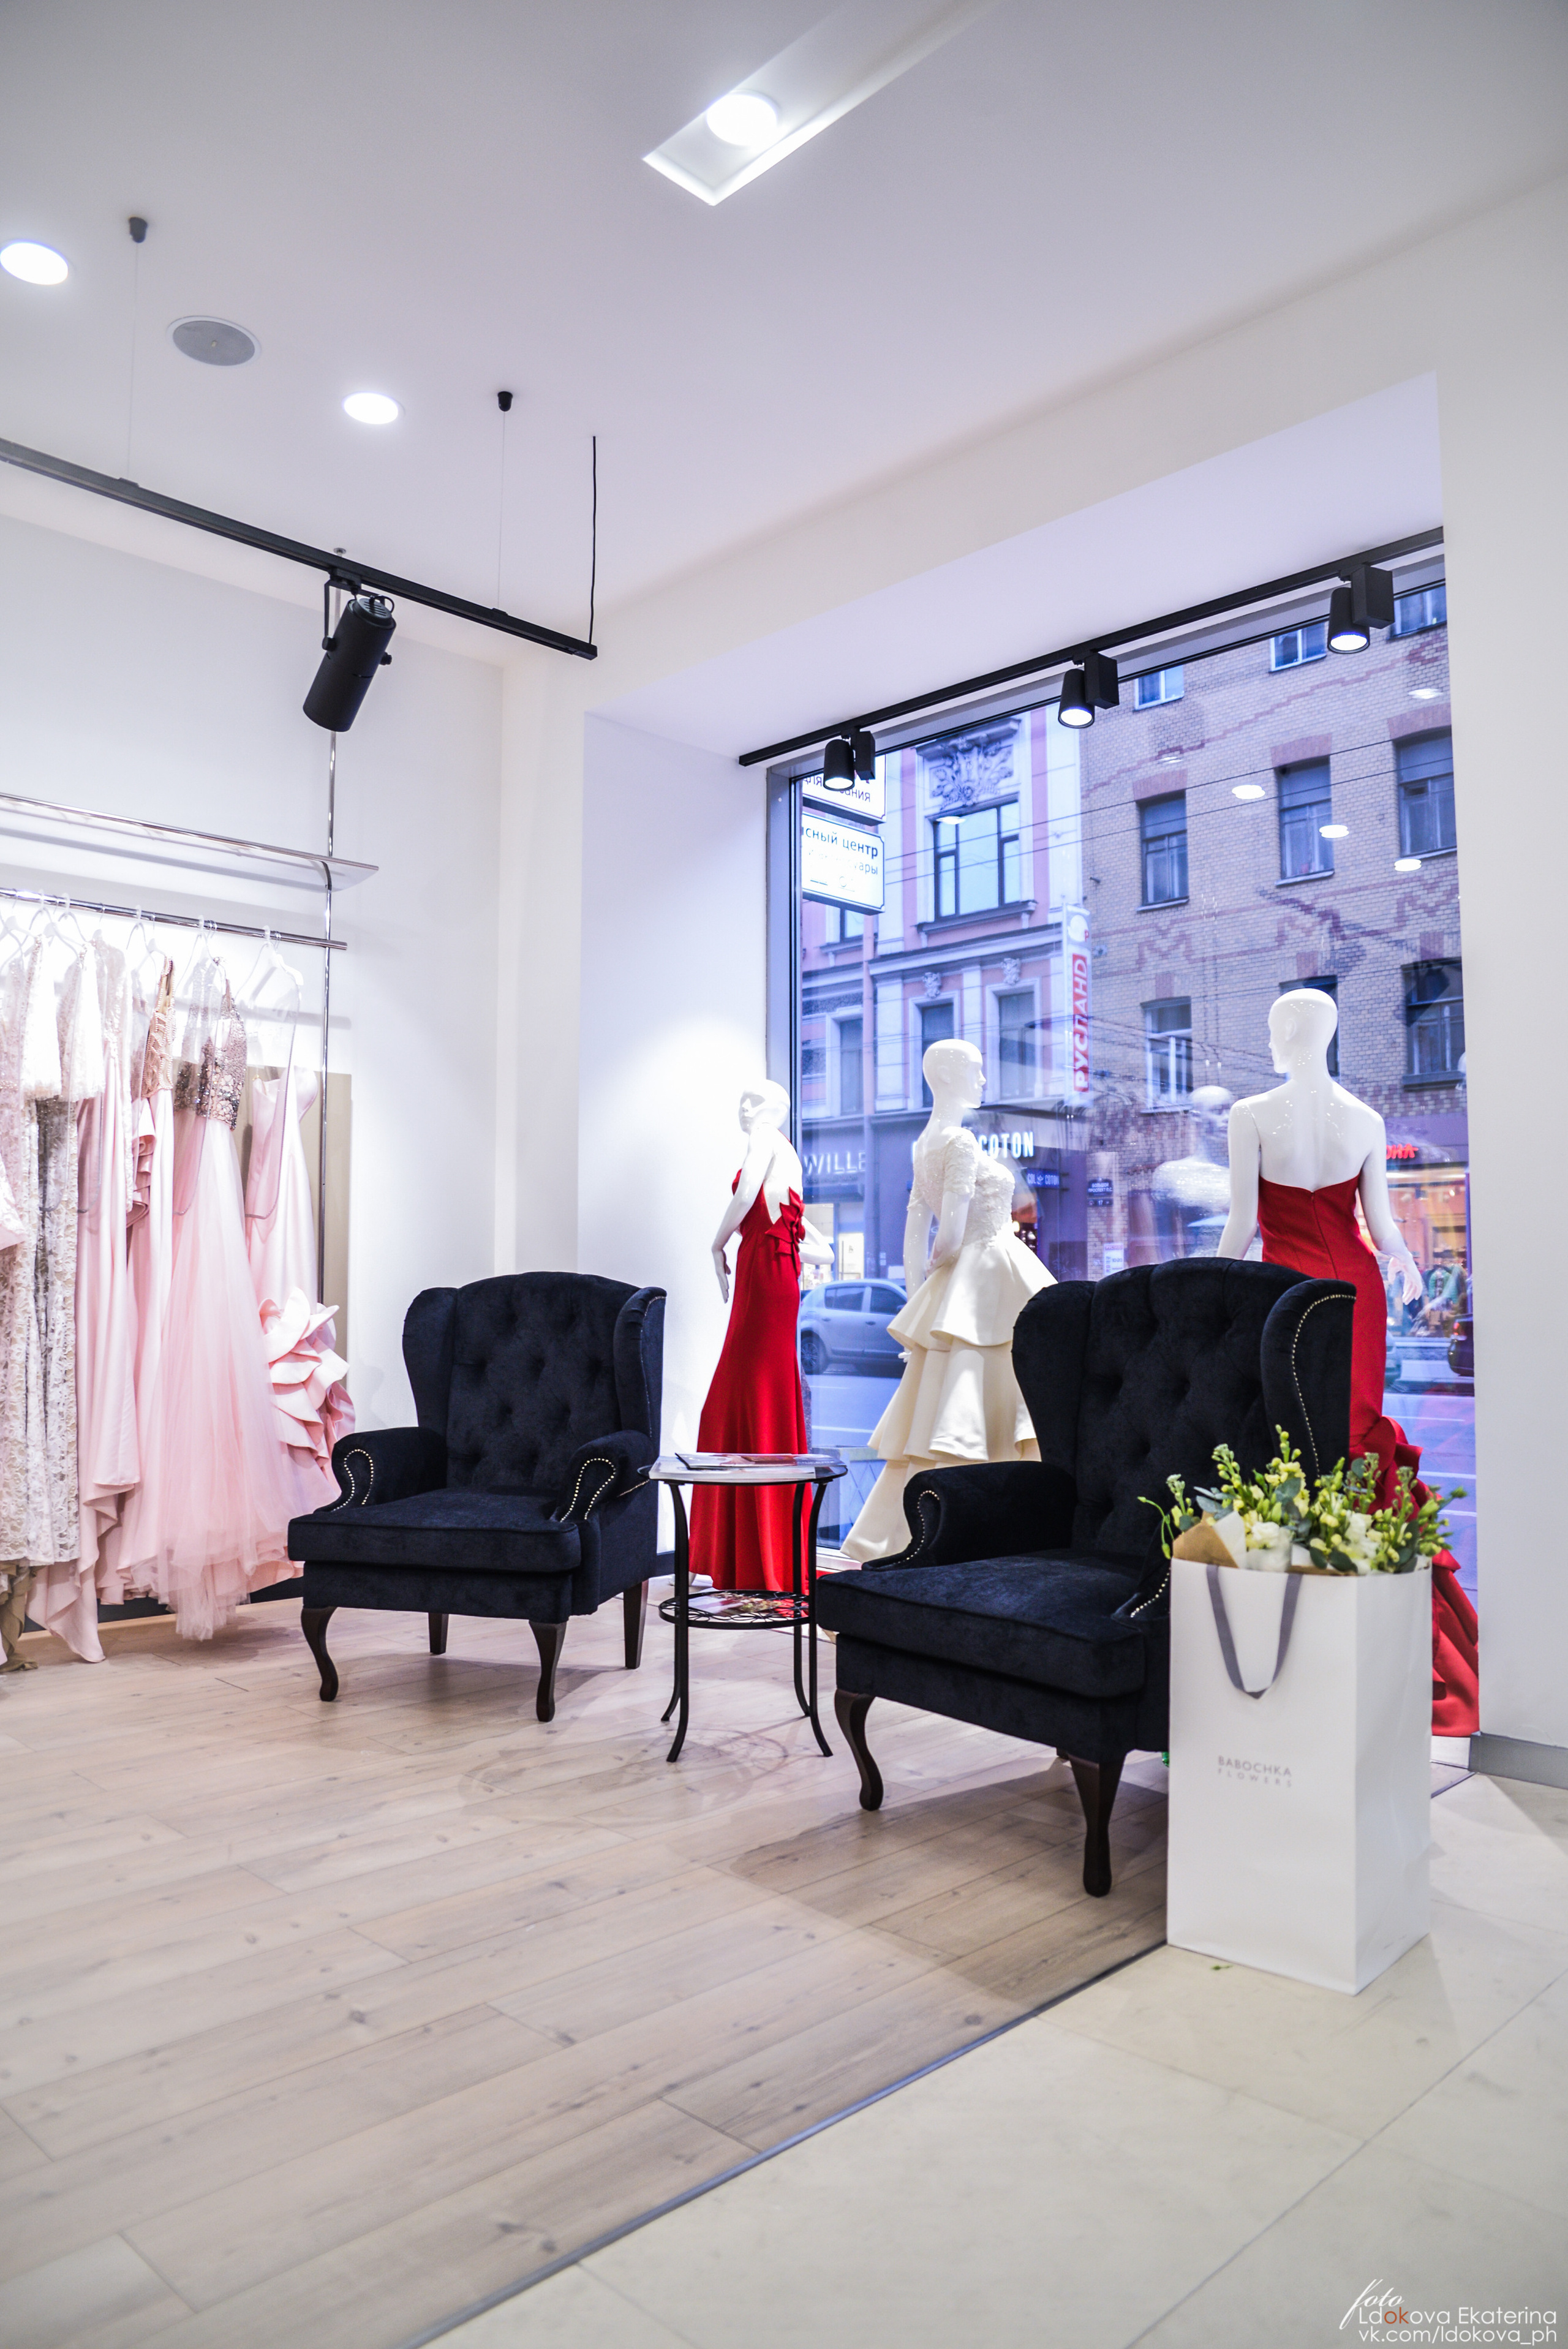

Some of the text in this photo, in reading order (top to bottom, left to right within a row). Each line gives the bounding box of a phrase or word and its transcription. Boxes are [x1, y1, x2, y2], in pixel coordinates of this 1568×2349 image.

[842, 839, 878, 859] центр
[978, 1131, 1034, 1159] COTON
[1218, 1755, 1292, 1776] BABOCHKA
[1218, 1767, 1292, 1788] FLOWERS
